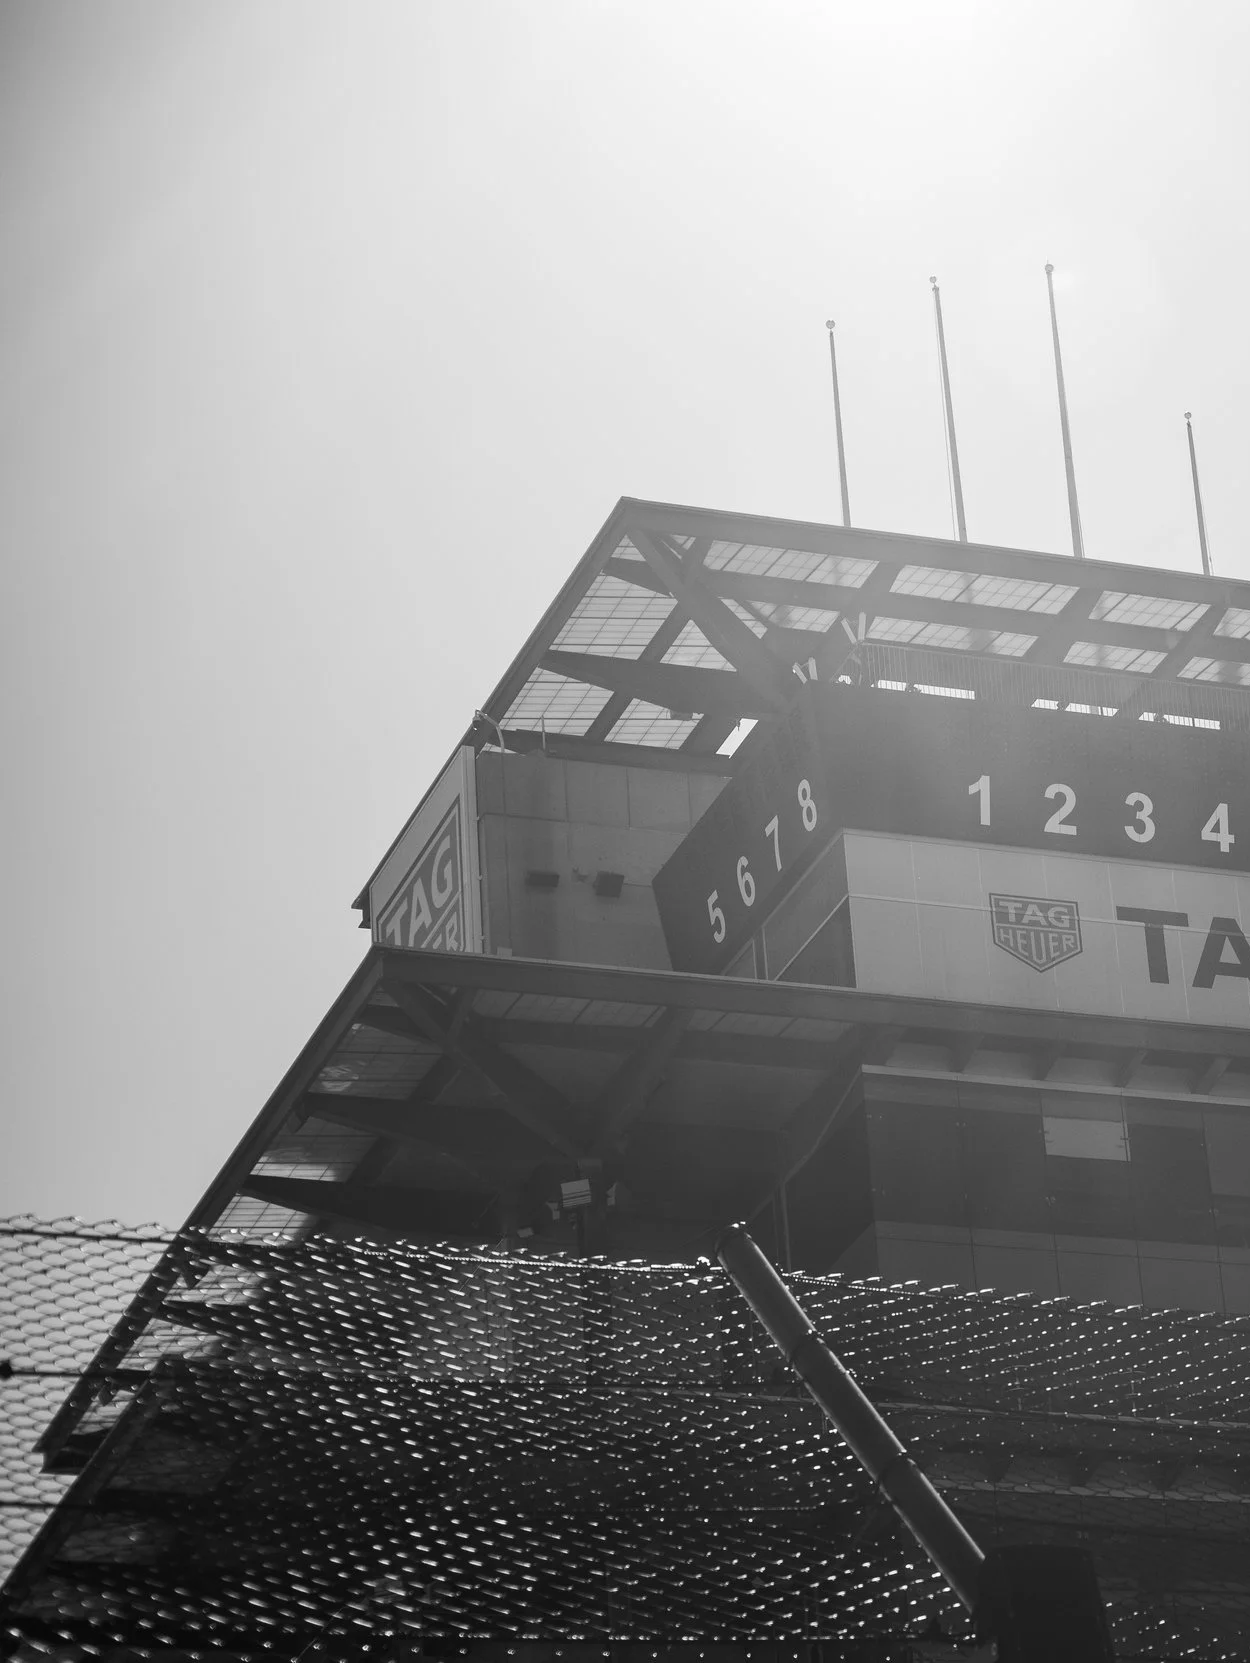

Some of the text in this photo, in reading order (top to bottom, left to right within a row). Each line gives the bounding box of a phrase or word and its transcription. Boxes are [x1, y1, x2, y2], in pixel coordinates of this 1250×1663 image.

[968, 775, 990, 826] 1
[1044, 783, 1077, 836] 2
[1124, 792, 1156, 843] 3
[1201, 803, 1235, 853] 4
[386, 835, 453, 947] TAG
[707, 779, 817, 943] 5 6 7 8
[999, 901, 1070, 928] TAG
[1000, 928, 1074, 964] HEUER
